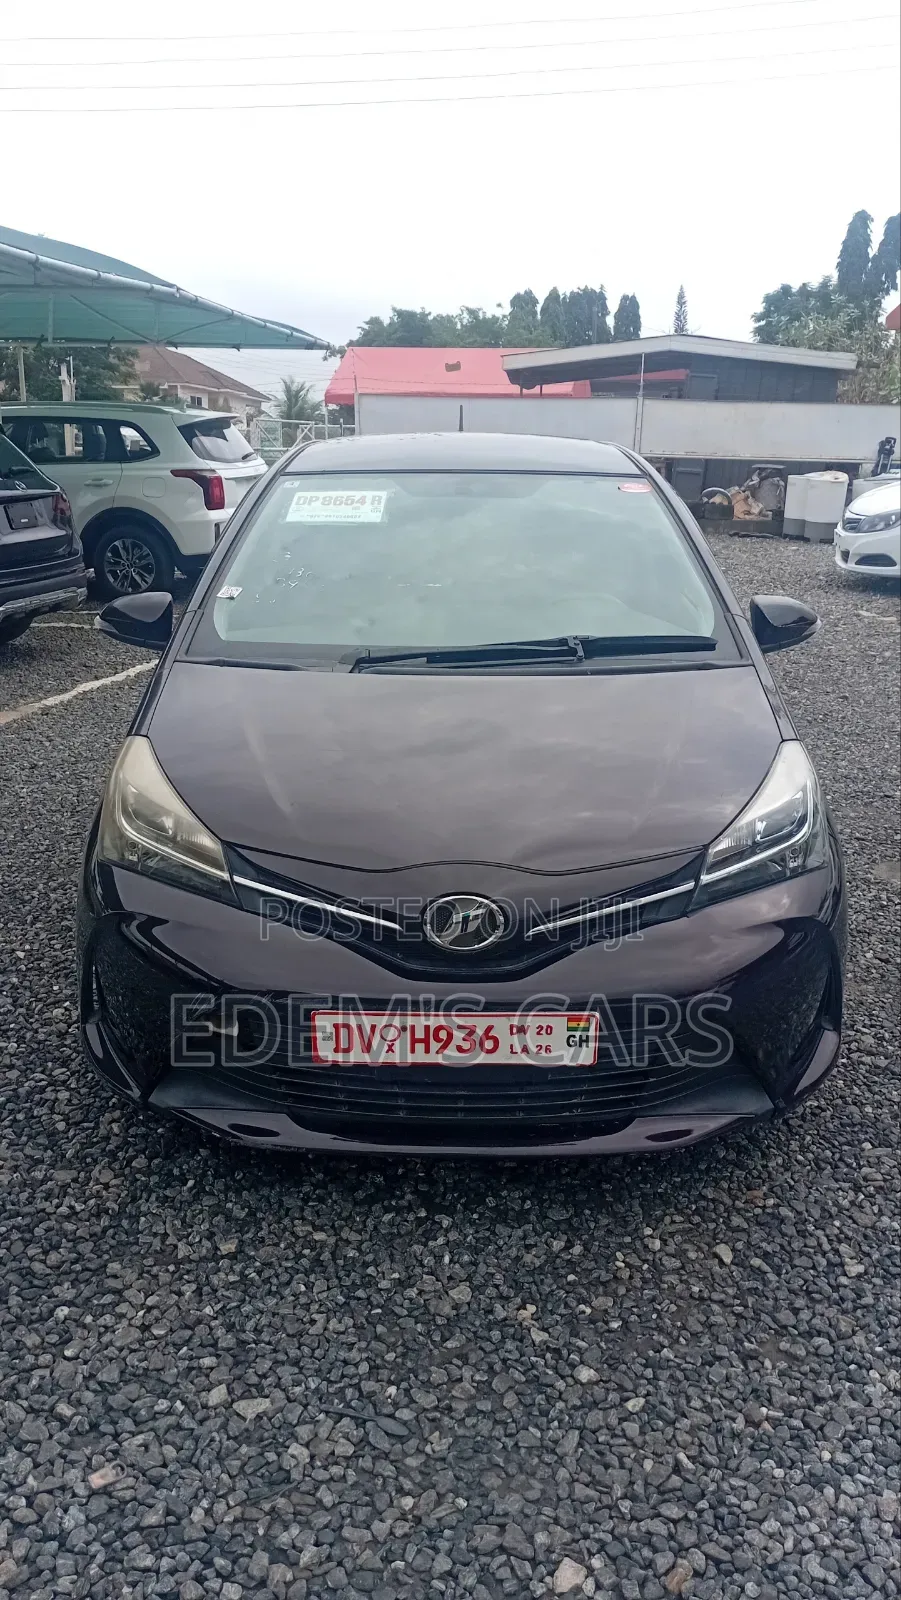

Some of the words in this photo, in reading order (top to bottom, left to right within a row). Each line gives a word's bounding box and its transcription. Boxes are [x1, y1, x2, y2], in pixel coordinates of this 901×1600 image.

[294, 495, 320, 506] DP
[320, 495, 367, 506] 8654
[370, 495, 383, 506] R
[536, 1024, 553, 1036] 20
[333, 1022, 377, 1053] DV
[409, 1024, 500, 1054] H936
[566, 1034, 589, 1048] GH
[509, 1044, 530, 1054] LA
[536, 1044, 552, 1054] 26
